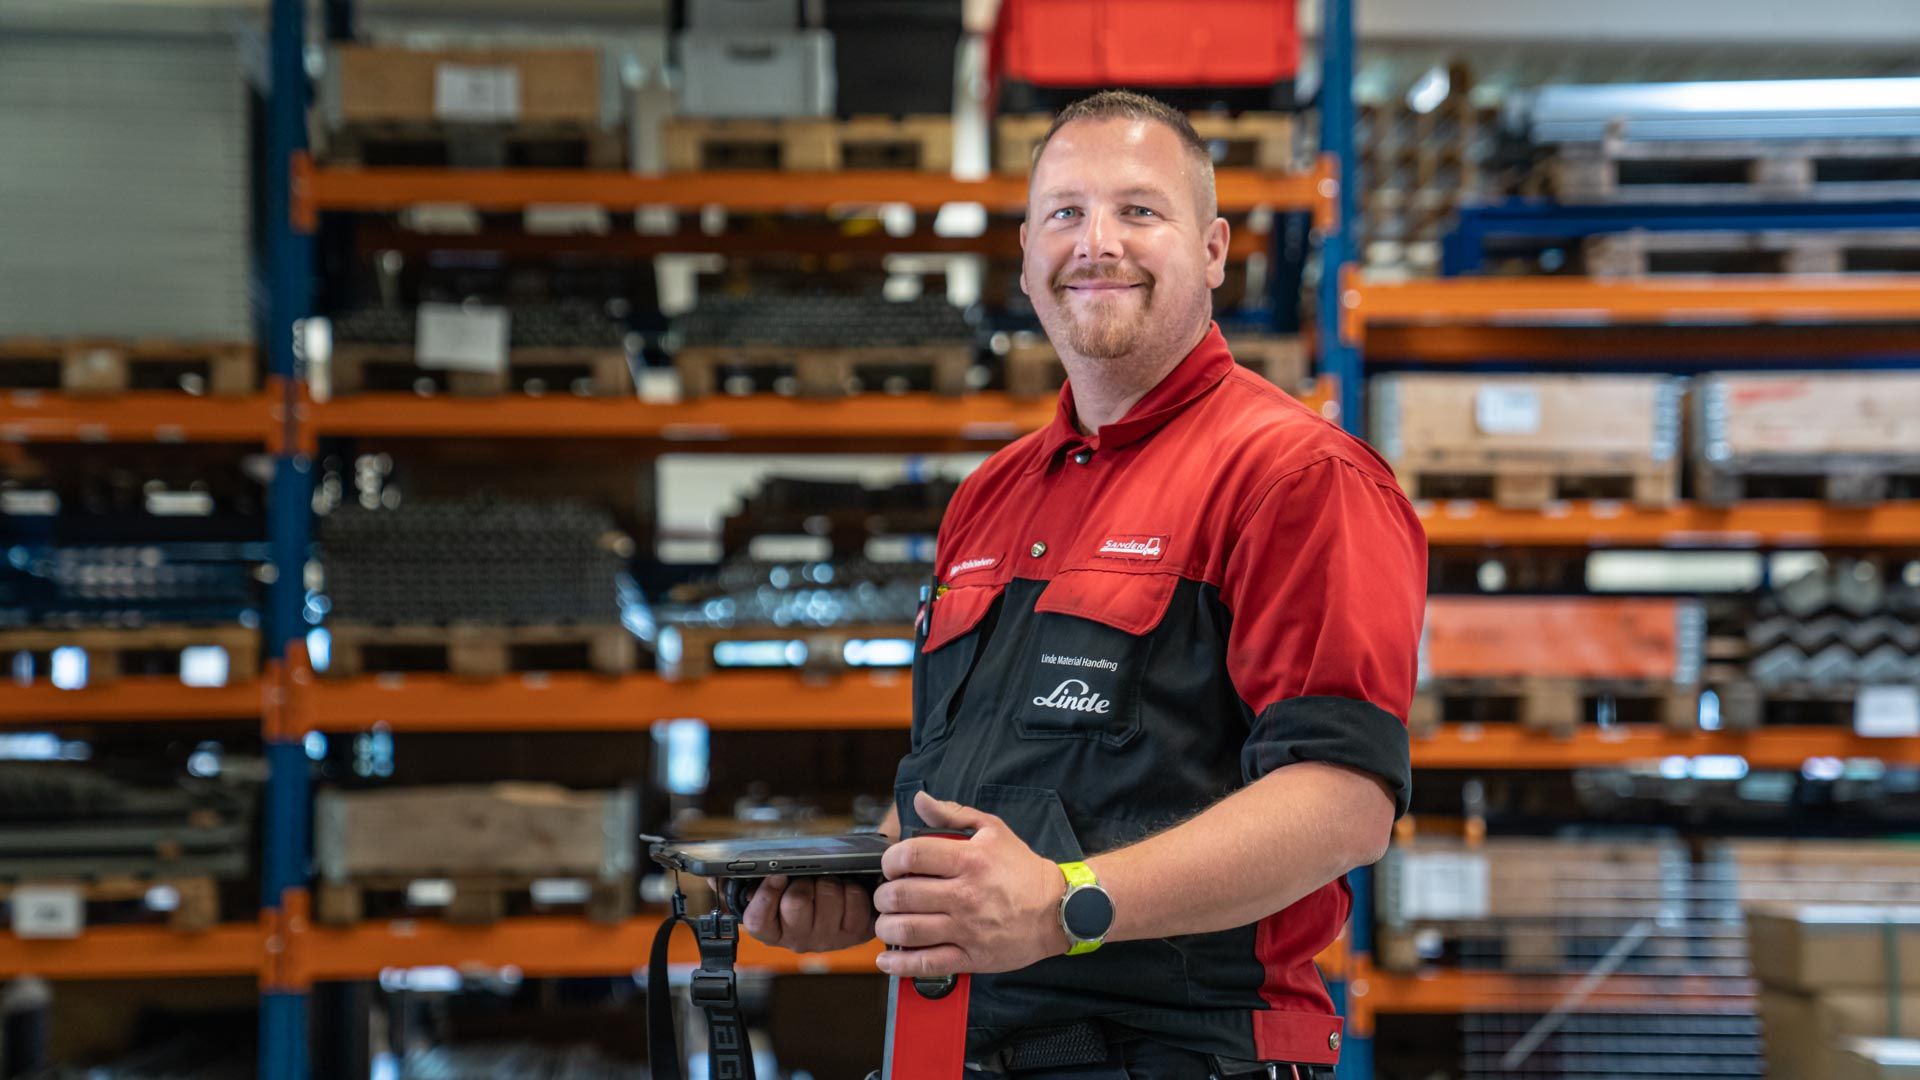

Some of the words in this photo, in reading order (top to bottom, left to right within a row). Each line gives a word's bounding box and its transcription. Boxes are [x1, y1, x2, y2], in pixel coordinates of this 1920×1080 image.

[1041, 653, 1057, 664] Linde
[1057, 655, 1082, 666] Material
[1082, 657, 1118, 672] Handling
[1032, 679, 1110, 714] Linde
